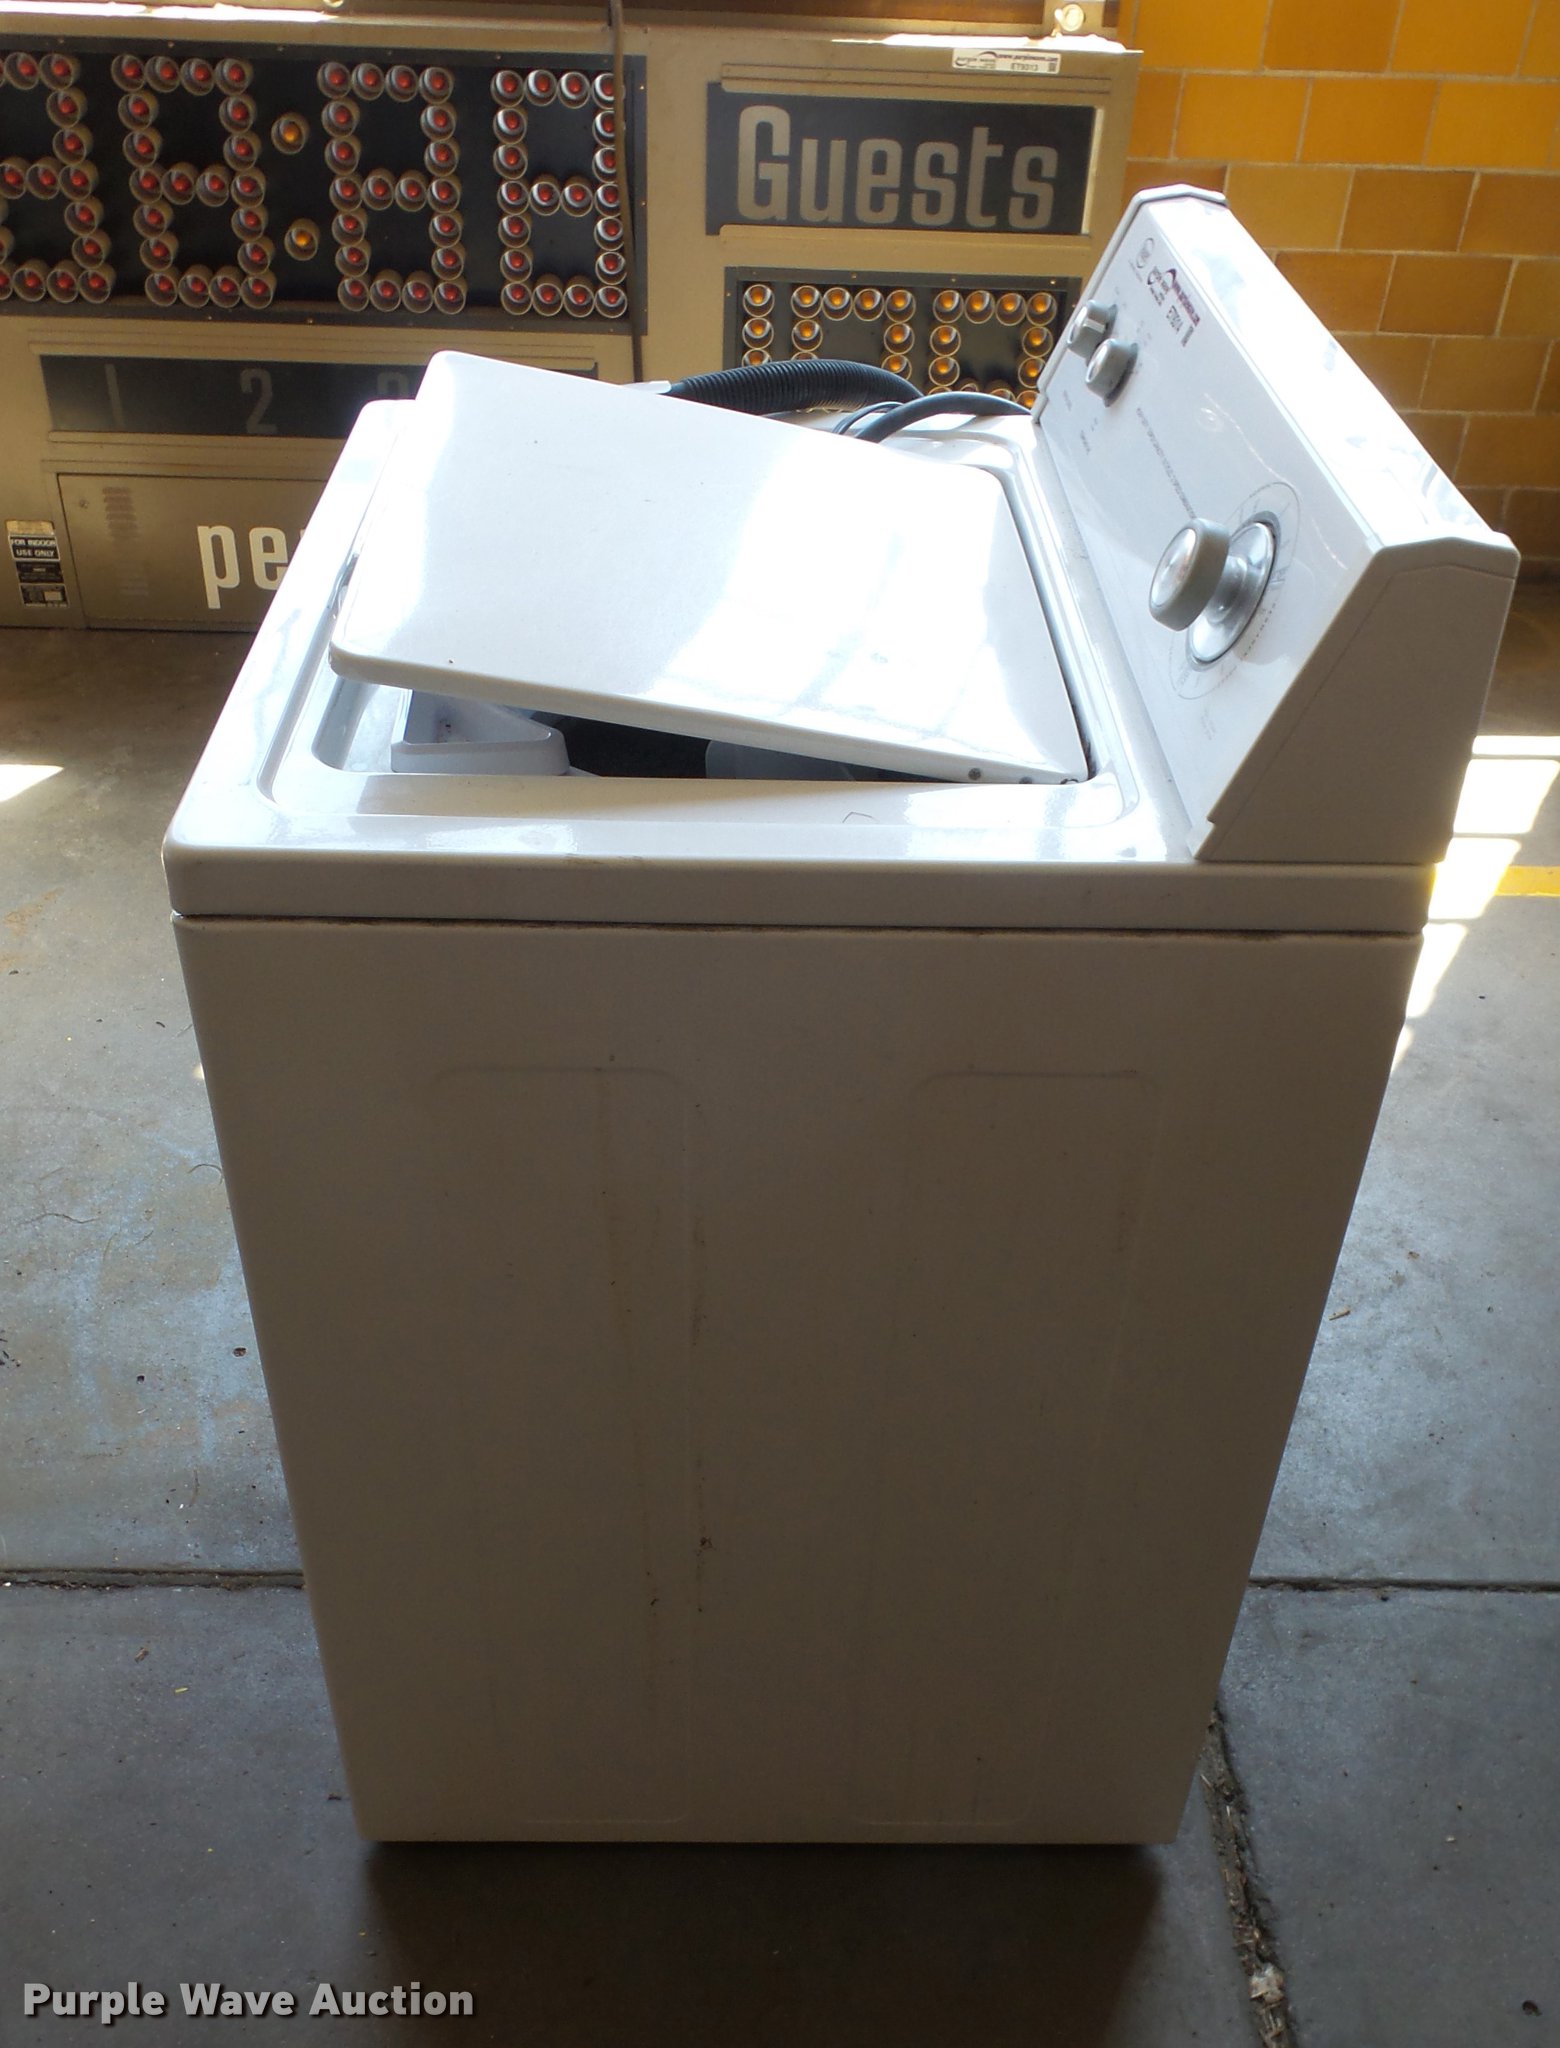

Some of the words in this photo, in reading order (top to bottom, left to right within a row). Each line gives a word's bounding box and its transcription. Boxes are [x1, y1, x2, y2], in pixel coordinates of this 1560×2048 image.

[737, 104, 1059, 230] Guests
[240, 367, 278, 435] 2
[16, 548, 33, 557] USE
[34, 549, 55, 558] ONLY
